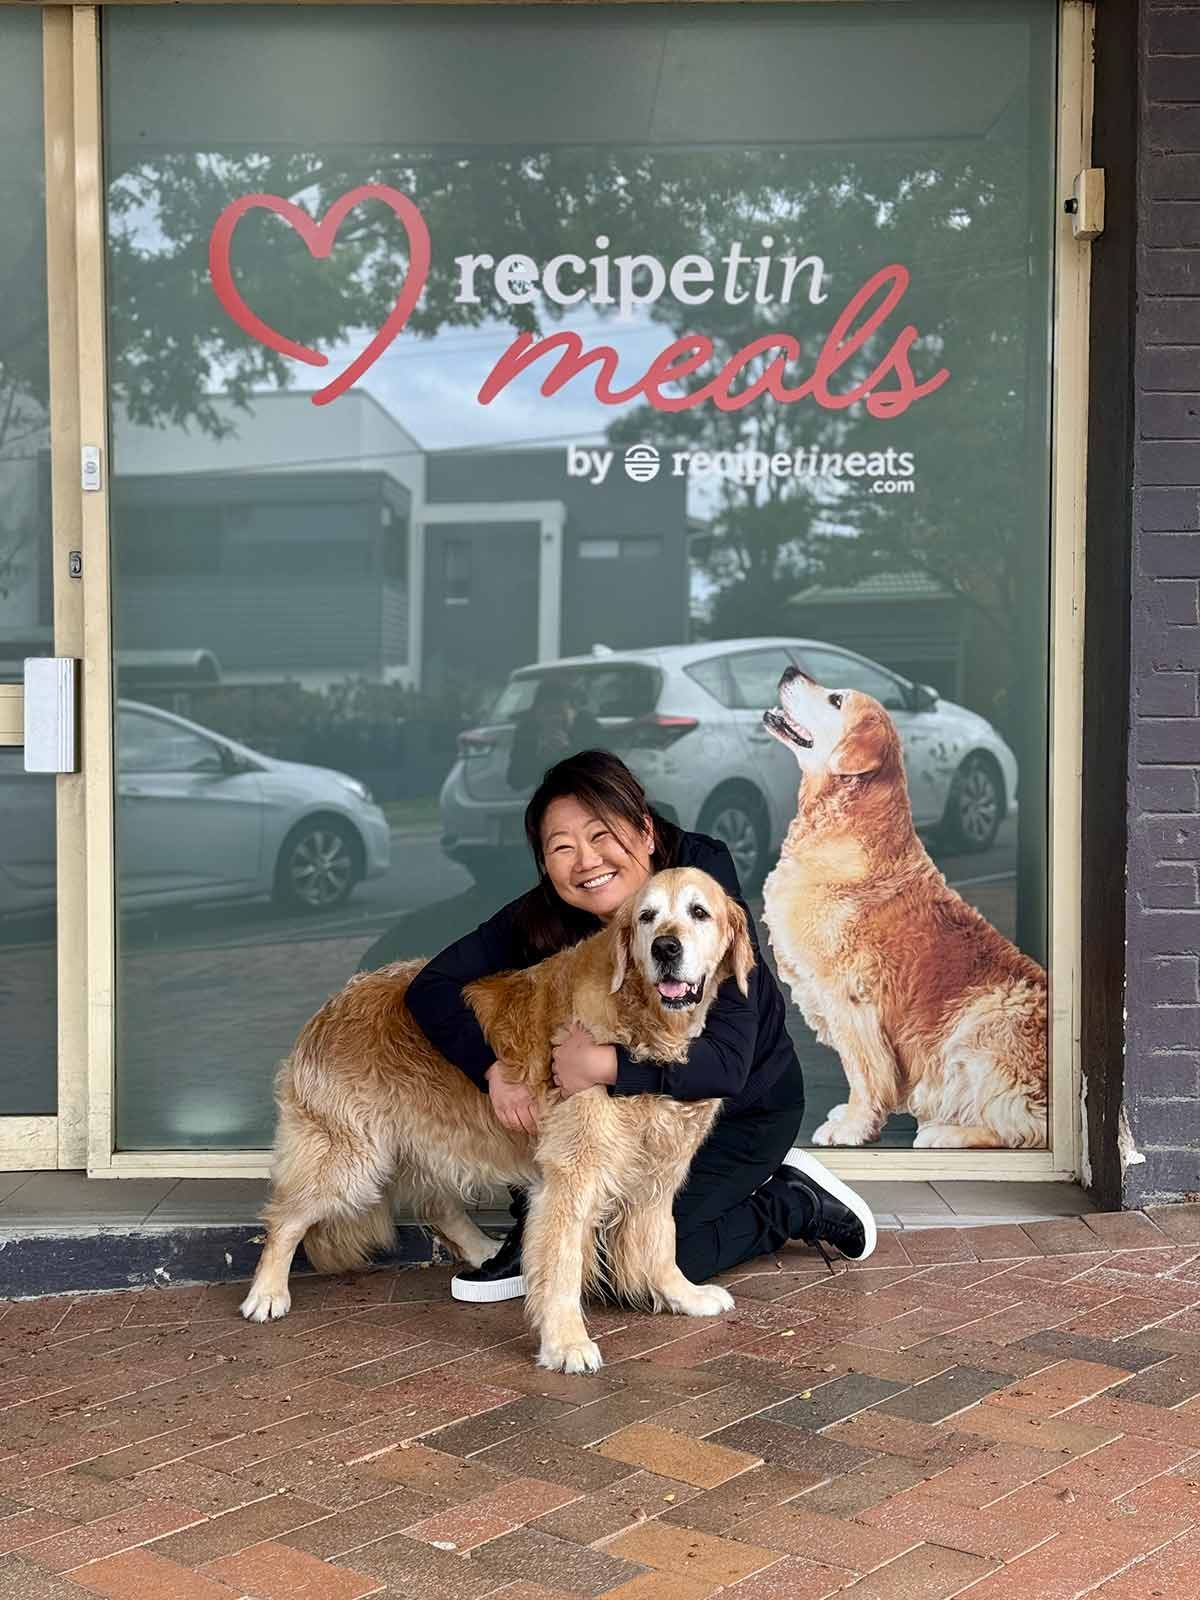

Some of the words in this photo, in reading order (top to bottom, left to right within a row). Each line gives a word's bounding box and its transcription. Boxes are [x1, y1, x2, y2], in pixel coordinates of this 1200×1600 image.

[453, 236, 827, 322] recipetin
[477, 263, 951, 420] meals
[566, 446, 614, 484] by
[672, 445, 916, 485] recipetineats
[868, 478, 915, 494] .com
